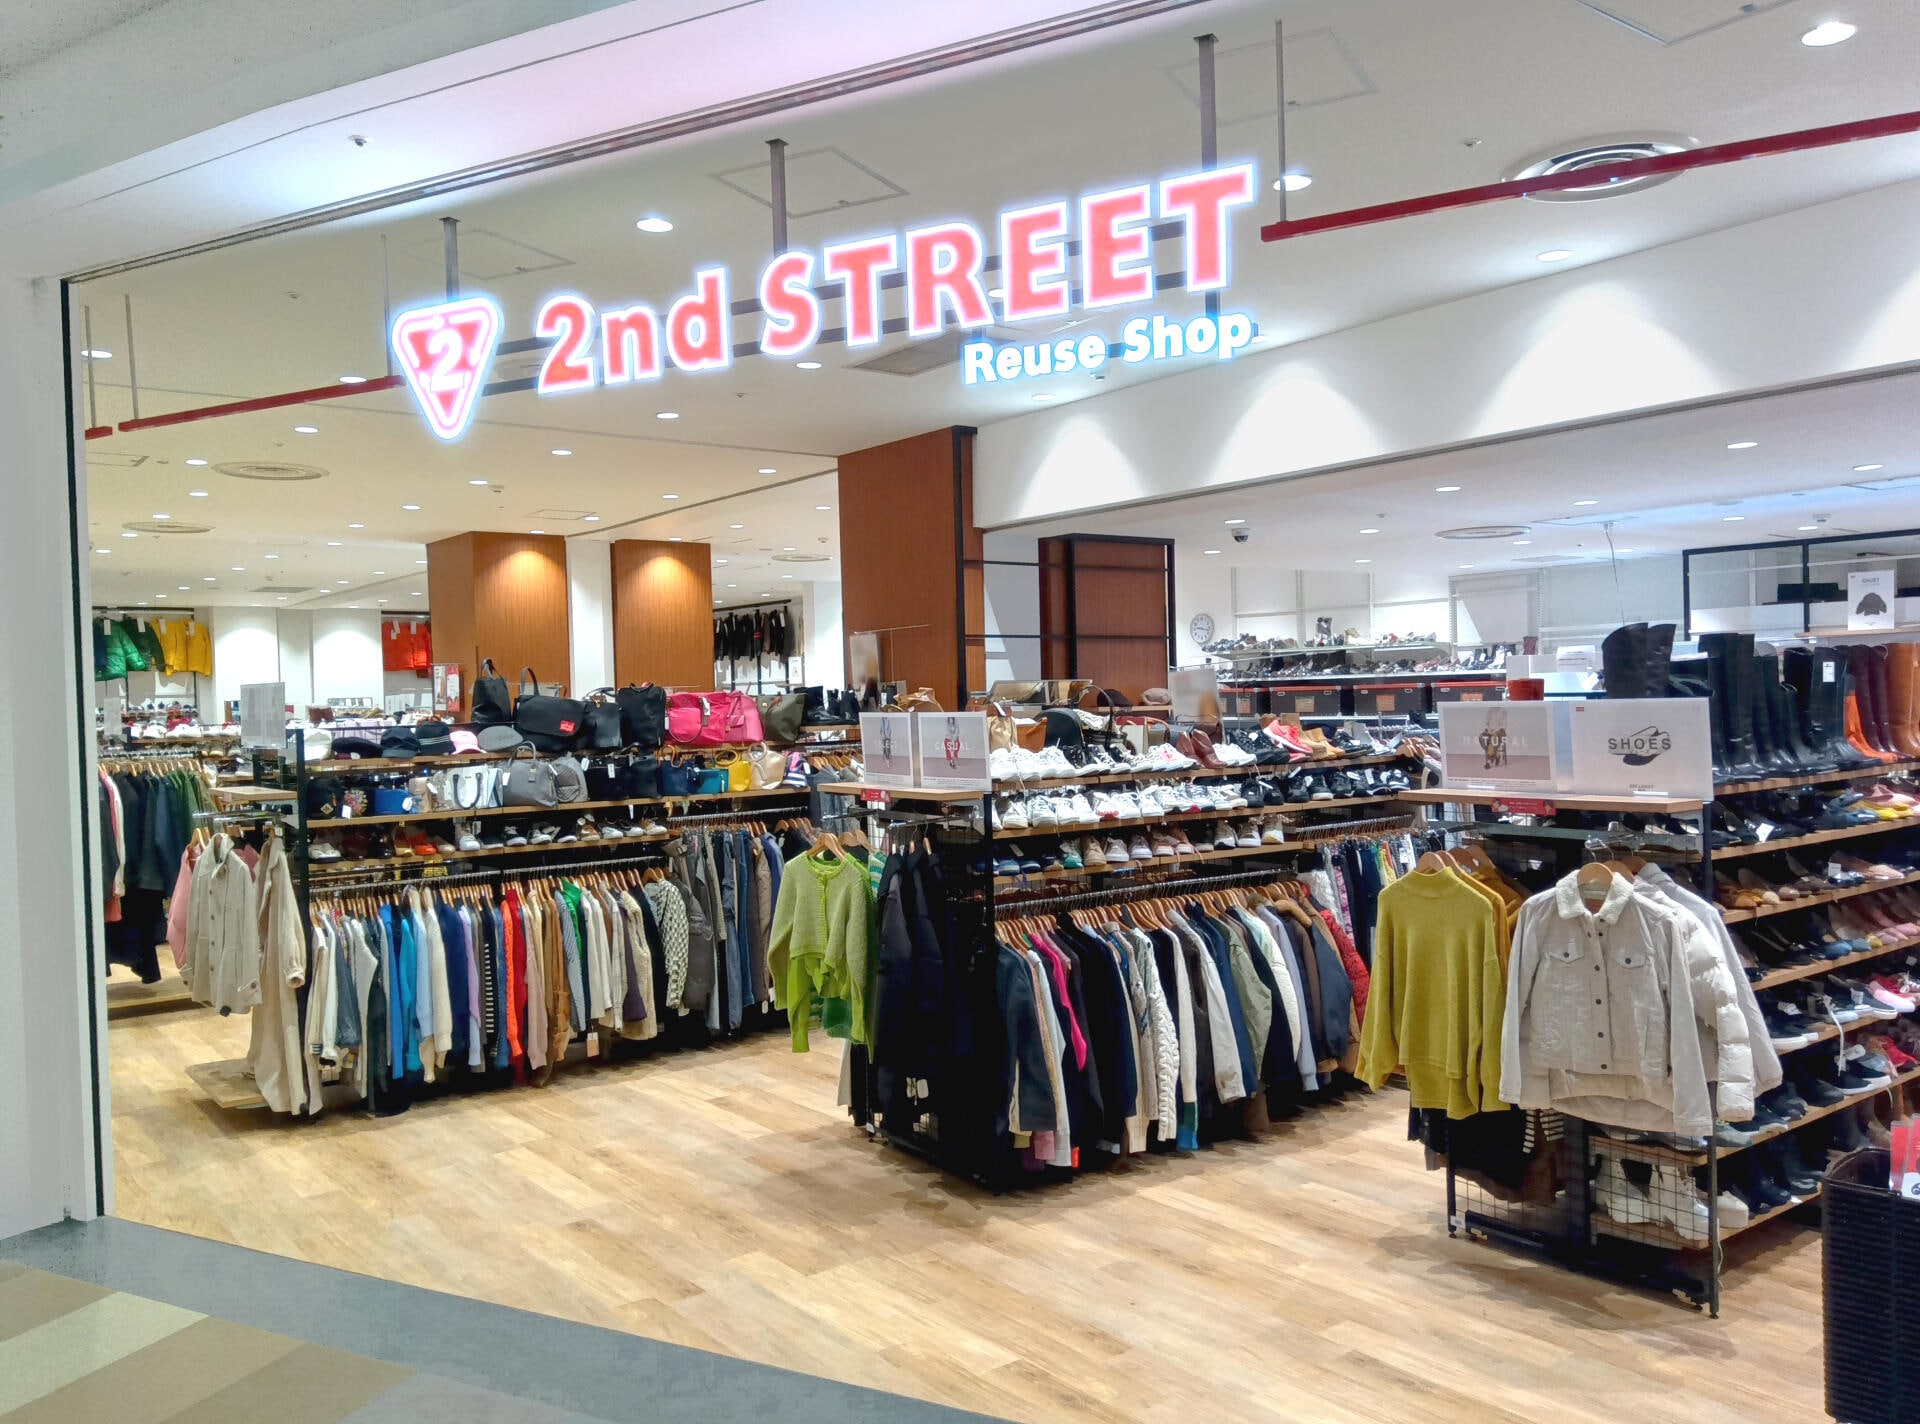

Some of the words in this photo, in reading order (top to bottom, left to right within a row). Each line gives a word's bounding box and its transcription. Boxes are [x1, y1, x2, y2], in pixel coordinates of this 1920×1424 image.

[536, 267, 730, 394] 2nd
[759, 163, 1257, 357] STREET
[427, 328, 464, 393] 2
[964, 334, 1107, 385] Reuse
[1123, 313, 1252, 361] Shop
[935, 741, 970, 751] CASUAL
[1463, 735, 1529, 747] NATURAL
[1608, 738, 1671, 750] SHOES
